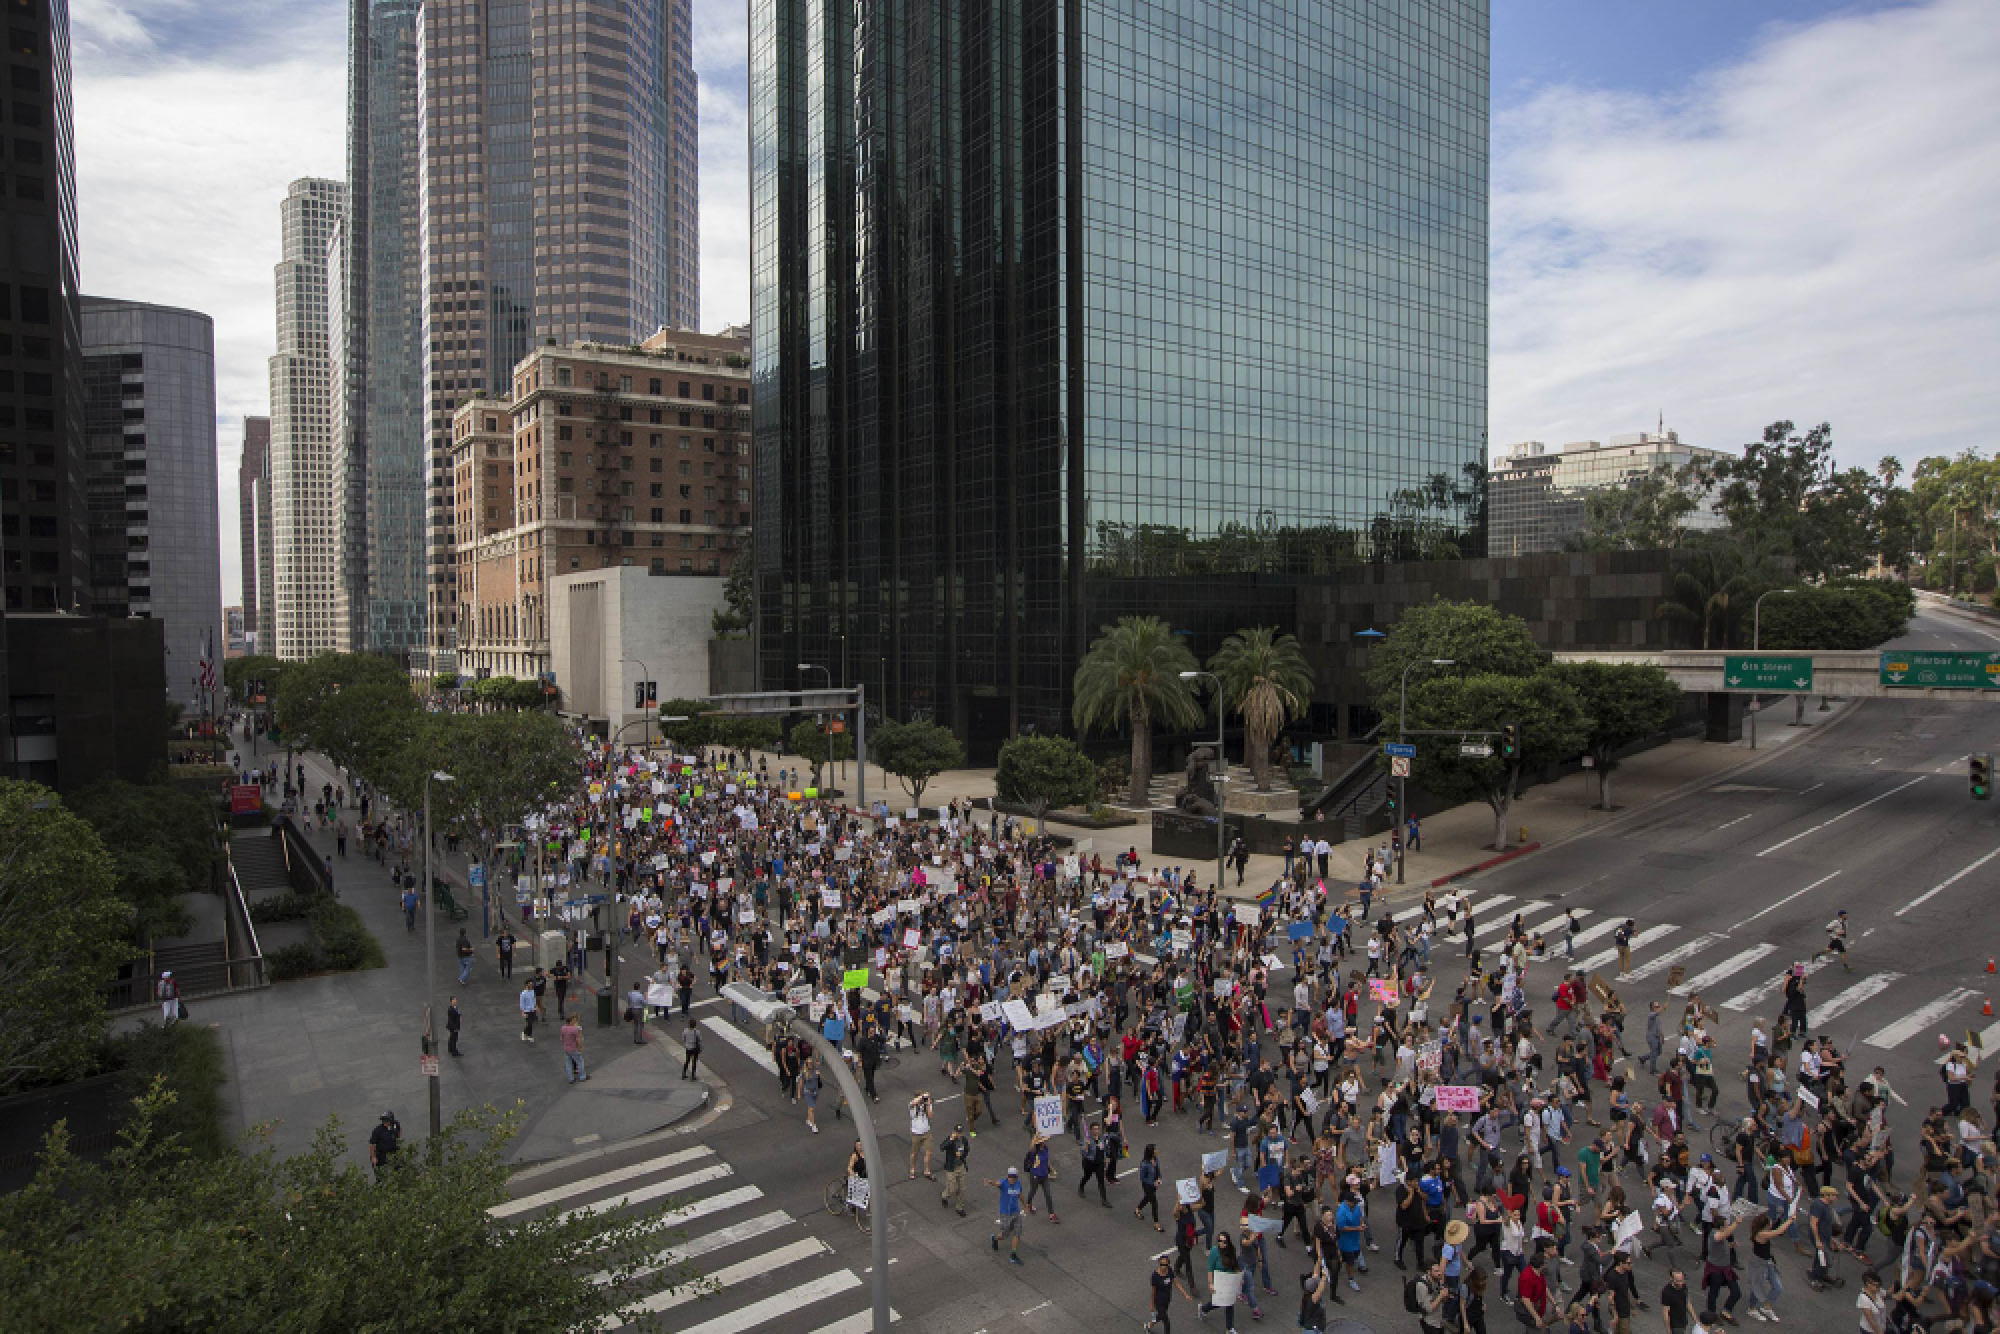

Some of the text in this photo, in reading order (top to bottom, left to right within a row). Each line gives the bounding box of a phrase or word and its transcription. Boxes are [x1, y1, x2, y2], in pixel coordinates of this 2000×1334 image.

[1913, 657, 1952, 666] Harbor
[1741, 662, 1793, 672] 6th Street
[1437, 1087, 1475, 1097] FUCK
[1437, 1097, 1477, 1109] TRUMP
